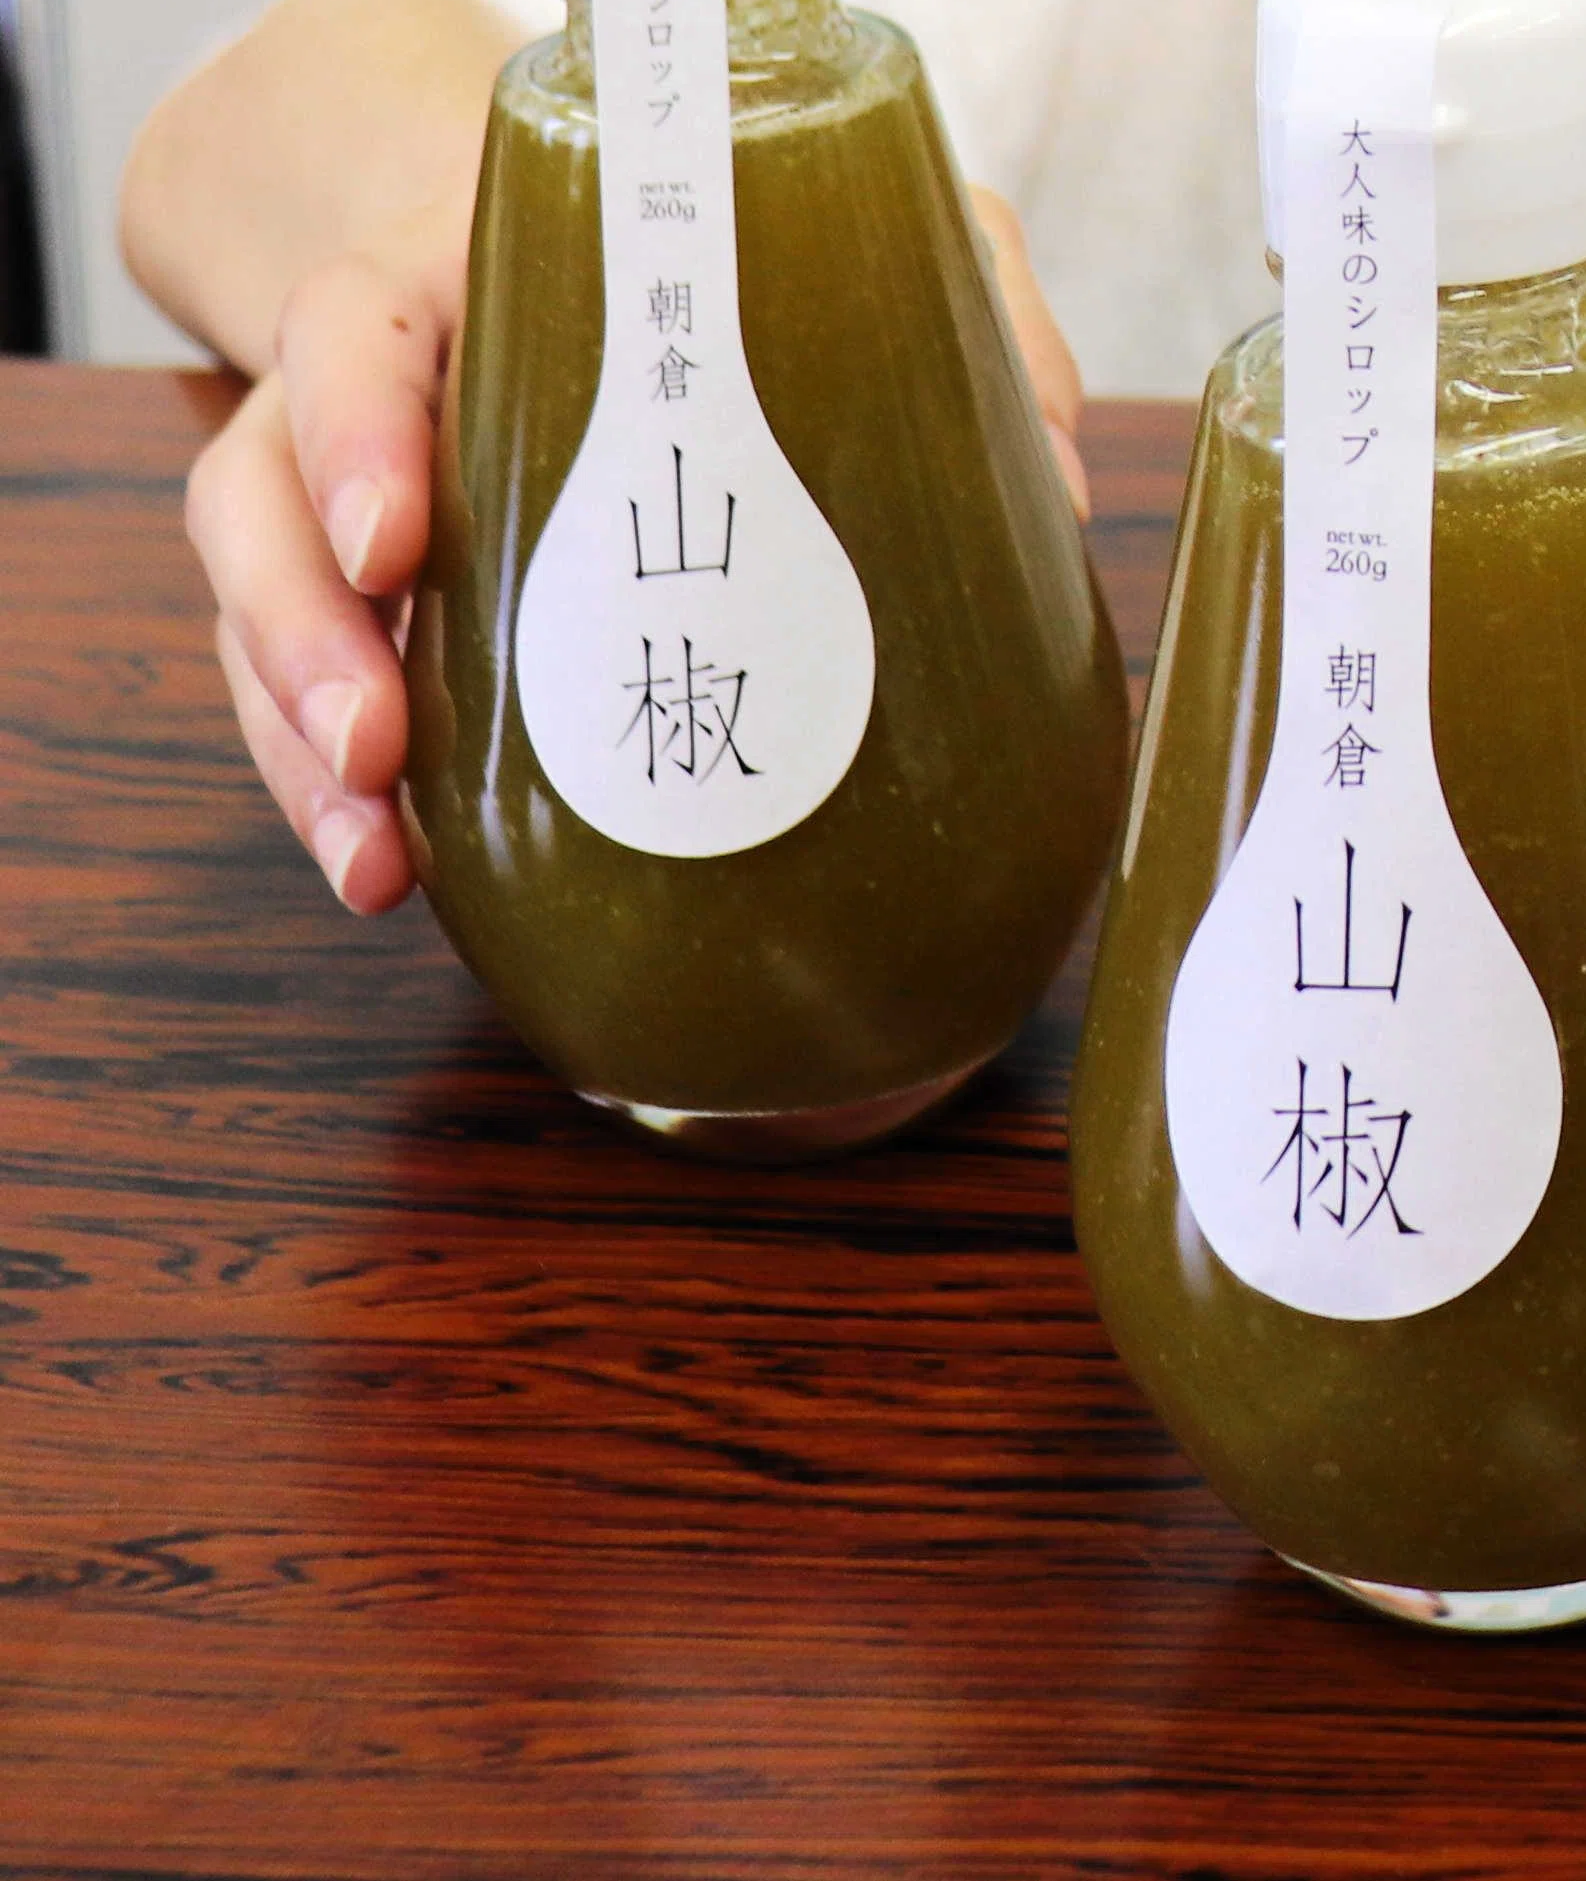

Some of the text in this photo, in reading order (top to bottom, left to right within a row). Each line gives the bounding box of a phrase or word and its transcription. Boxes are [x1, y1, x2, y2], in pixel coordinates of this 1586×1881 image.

[640, 198, 696, 224] 260g
[1338, 119, 1379, 466] 大人味のシロップ
[1326, 529, 1387, 546] net wt.
[1325, 549, 1387, 580] 260g
